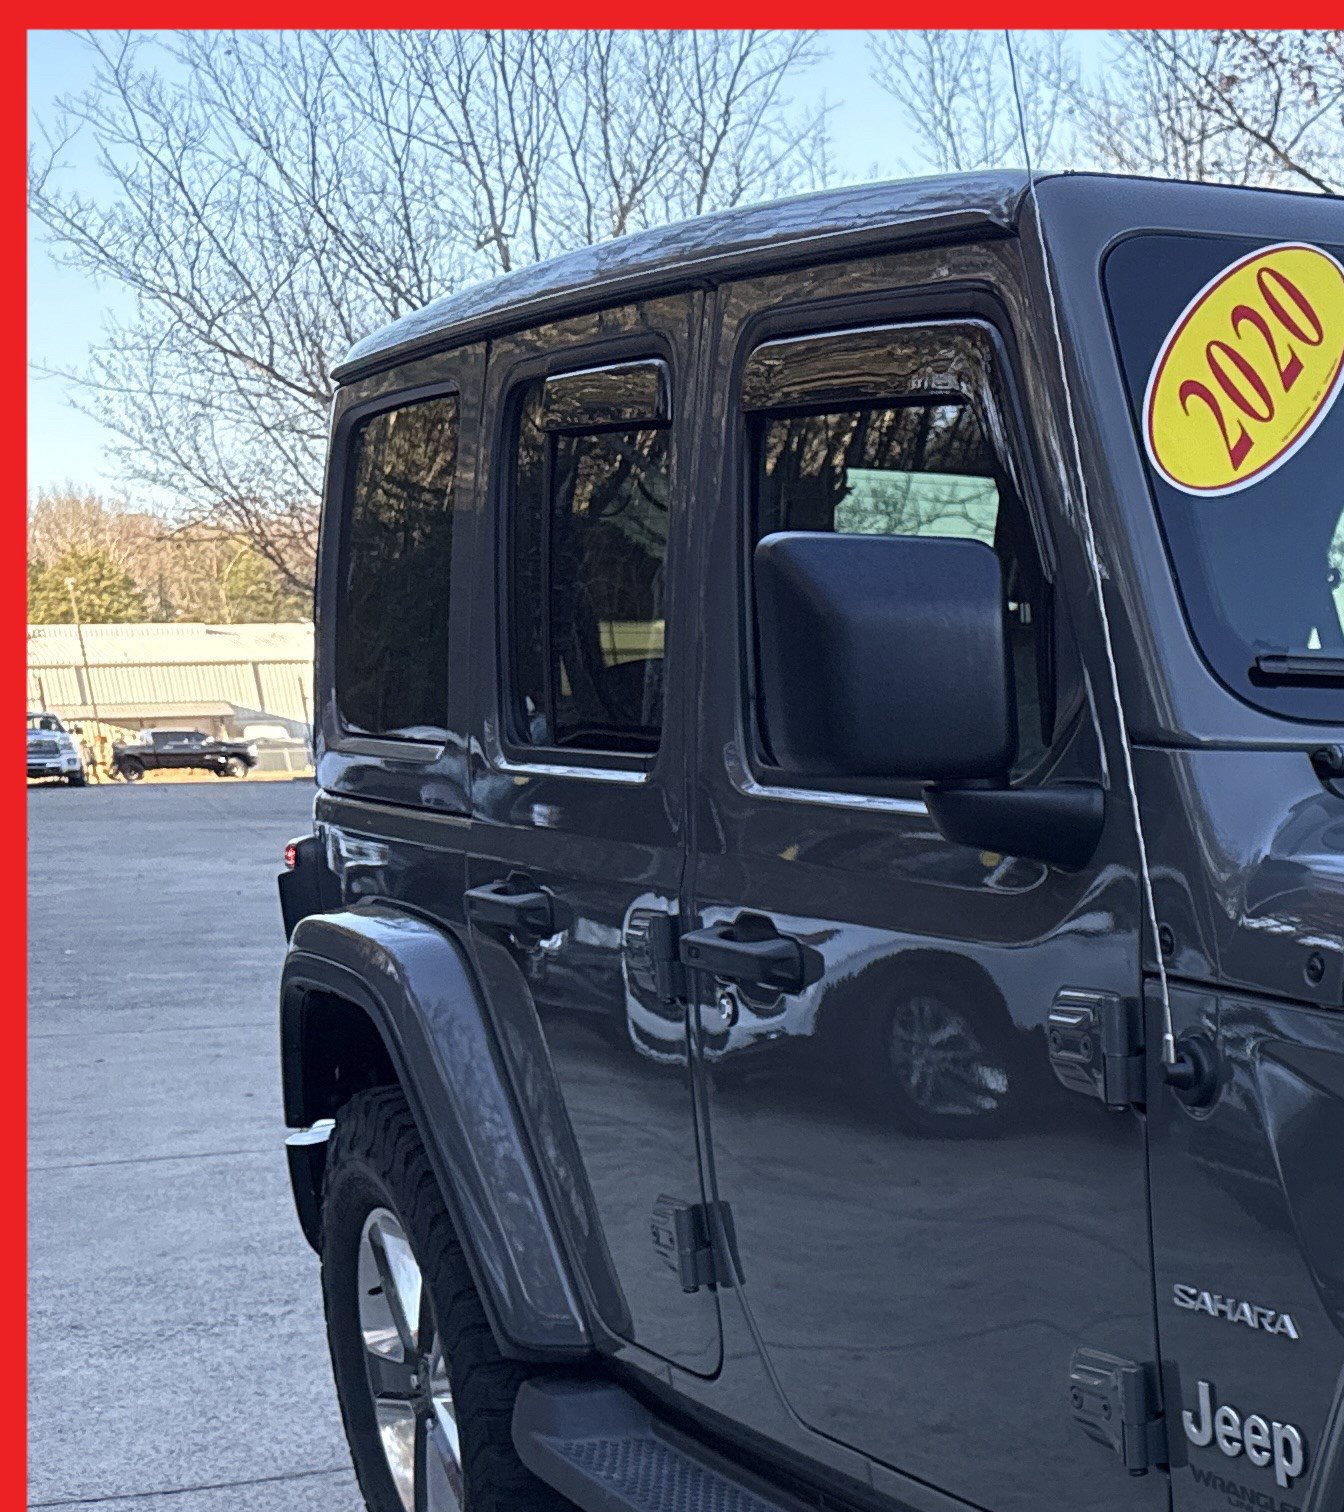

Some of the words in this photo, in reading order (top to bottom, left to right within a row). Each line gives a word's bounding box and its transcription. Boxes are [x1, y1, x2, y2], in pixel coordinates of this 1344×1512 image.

[1179, 267, 1324, 471] 2020
[1173, 1284, 1299, 1340] SAHARA
[1182, 1381, 1304, 1488] Jeep
